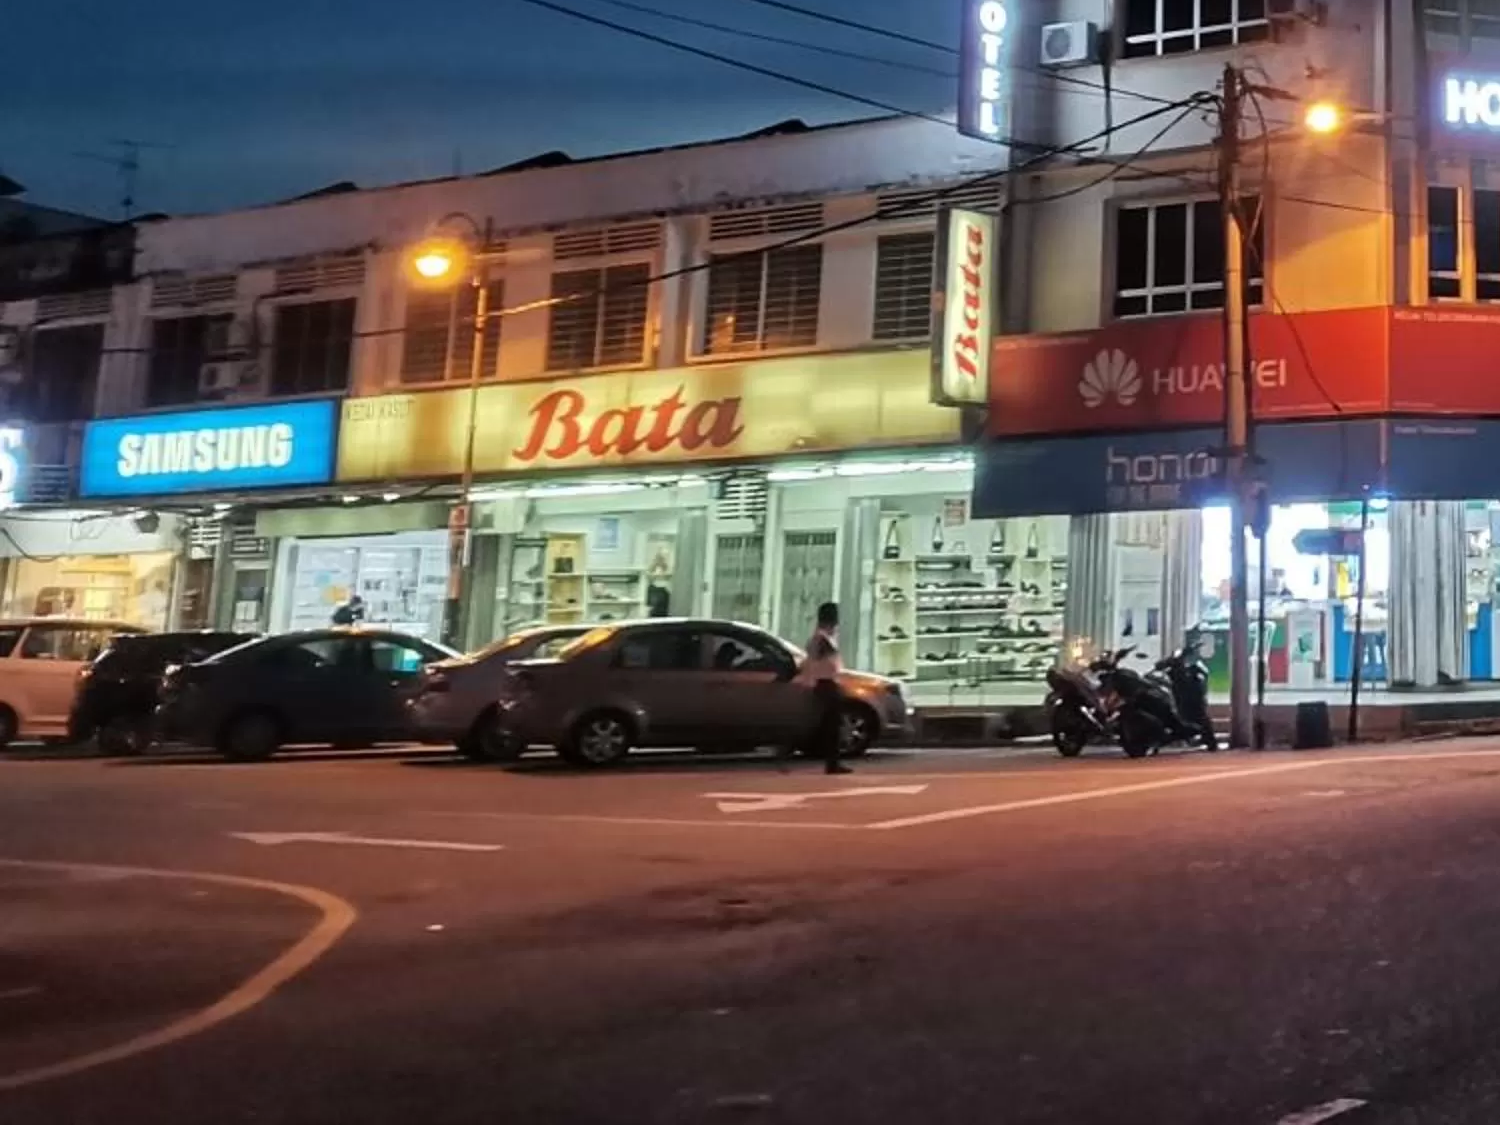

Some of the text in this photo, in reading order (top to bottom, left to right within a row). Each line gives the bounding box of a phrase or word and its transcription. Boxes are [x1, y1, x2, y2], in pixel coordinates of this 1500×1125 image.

[955, 225, 985, 379] Bata
[117, 422, 293, 477] SAMSUNG
[511, 383, 745, 461] Bata
